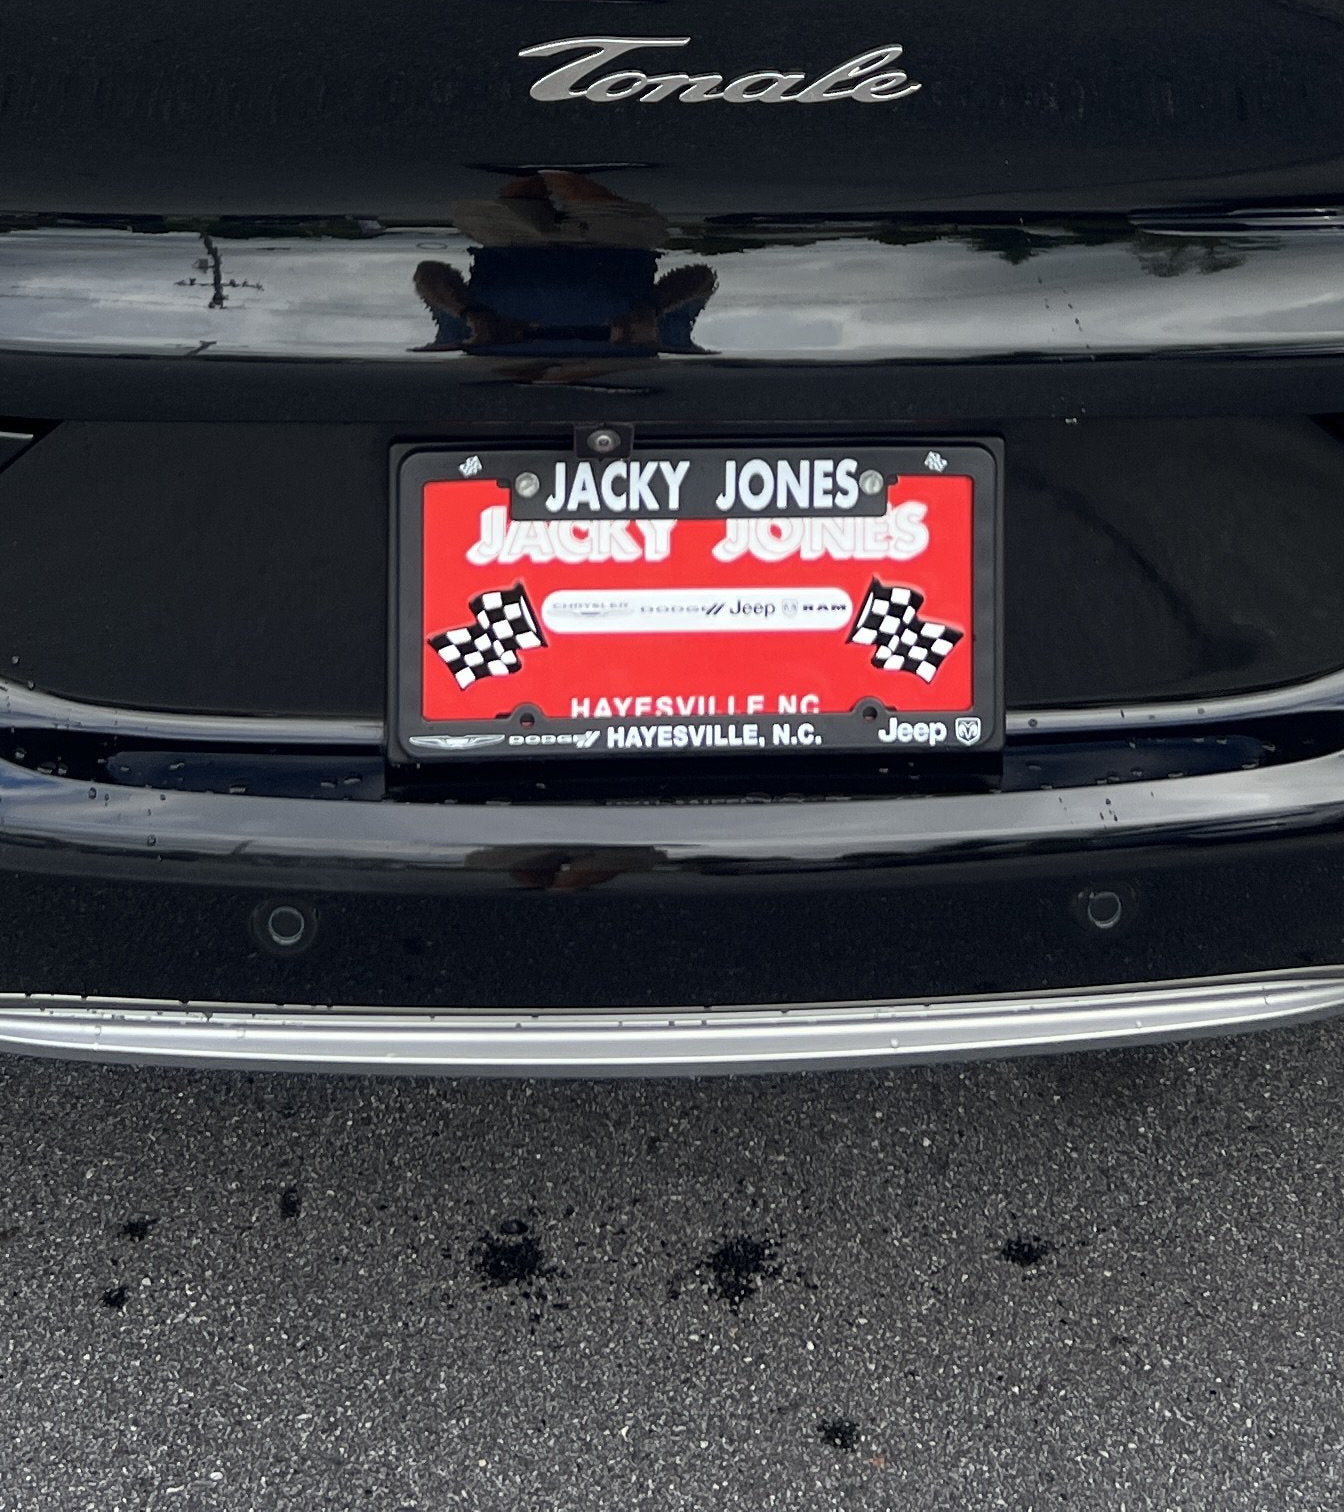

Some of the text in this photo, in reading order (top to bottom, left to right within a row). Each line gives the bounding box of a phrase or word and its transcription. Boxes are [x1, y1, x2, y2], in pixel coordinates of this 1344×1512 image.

[518, 35, 923, 103] Tonale
[545, 458, 859, 512] JACKY JONES
[465, 500, 931, 566] JACKY JONES
[729, 600, 776, 618] Jeep
[802, 603, 847, 611] RAM
[607, 723, 823, 749] HAYESVILLE, N.C.
[877, 717, 948, 747] Jeep
